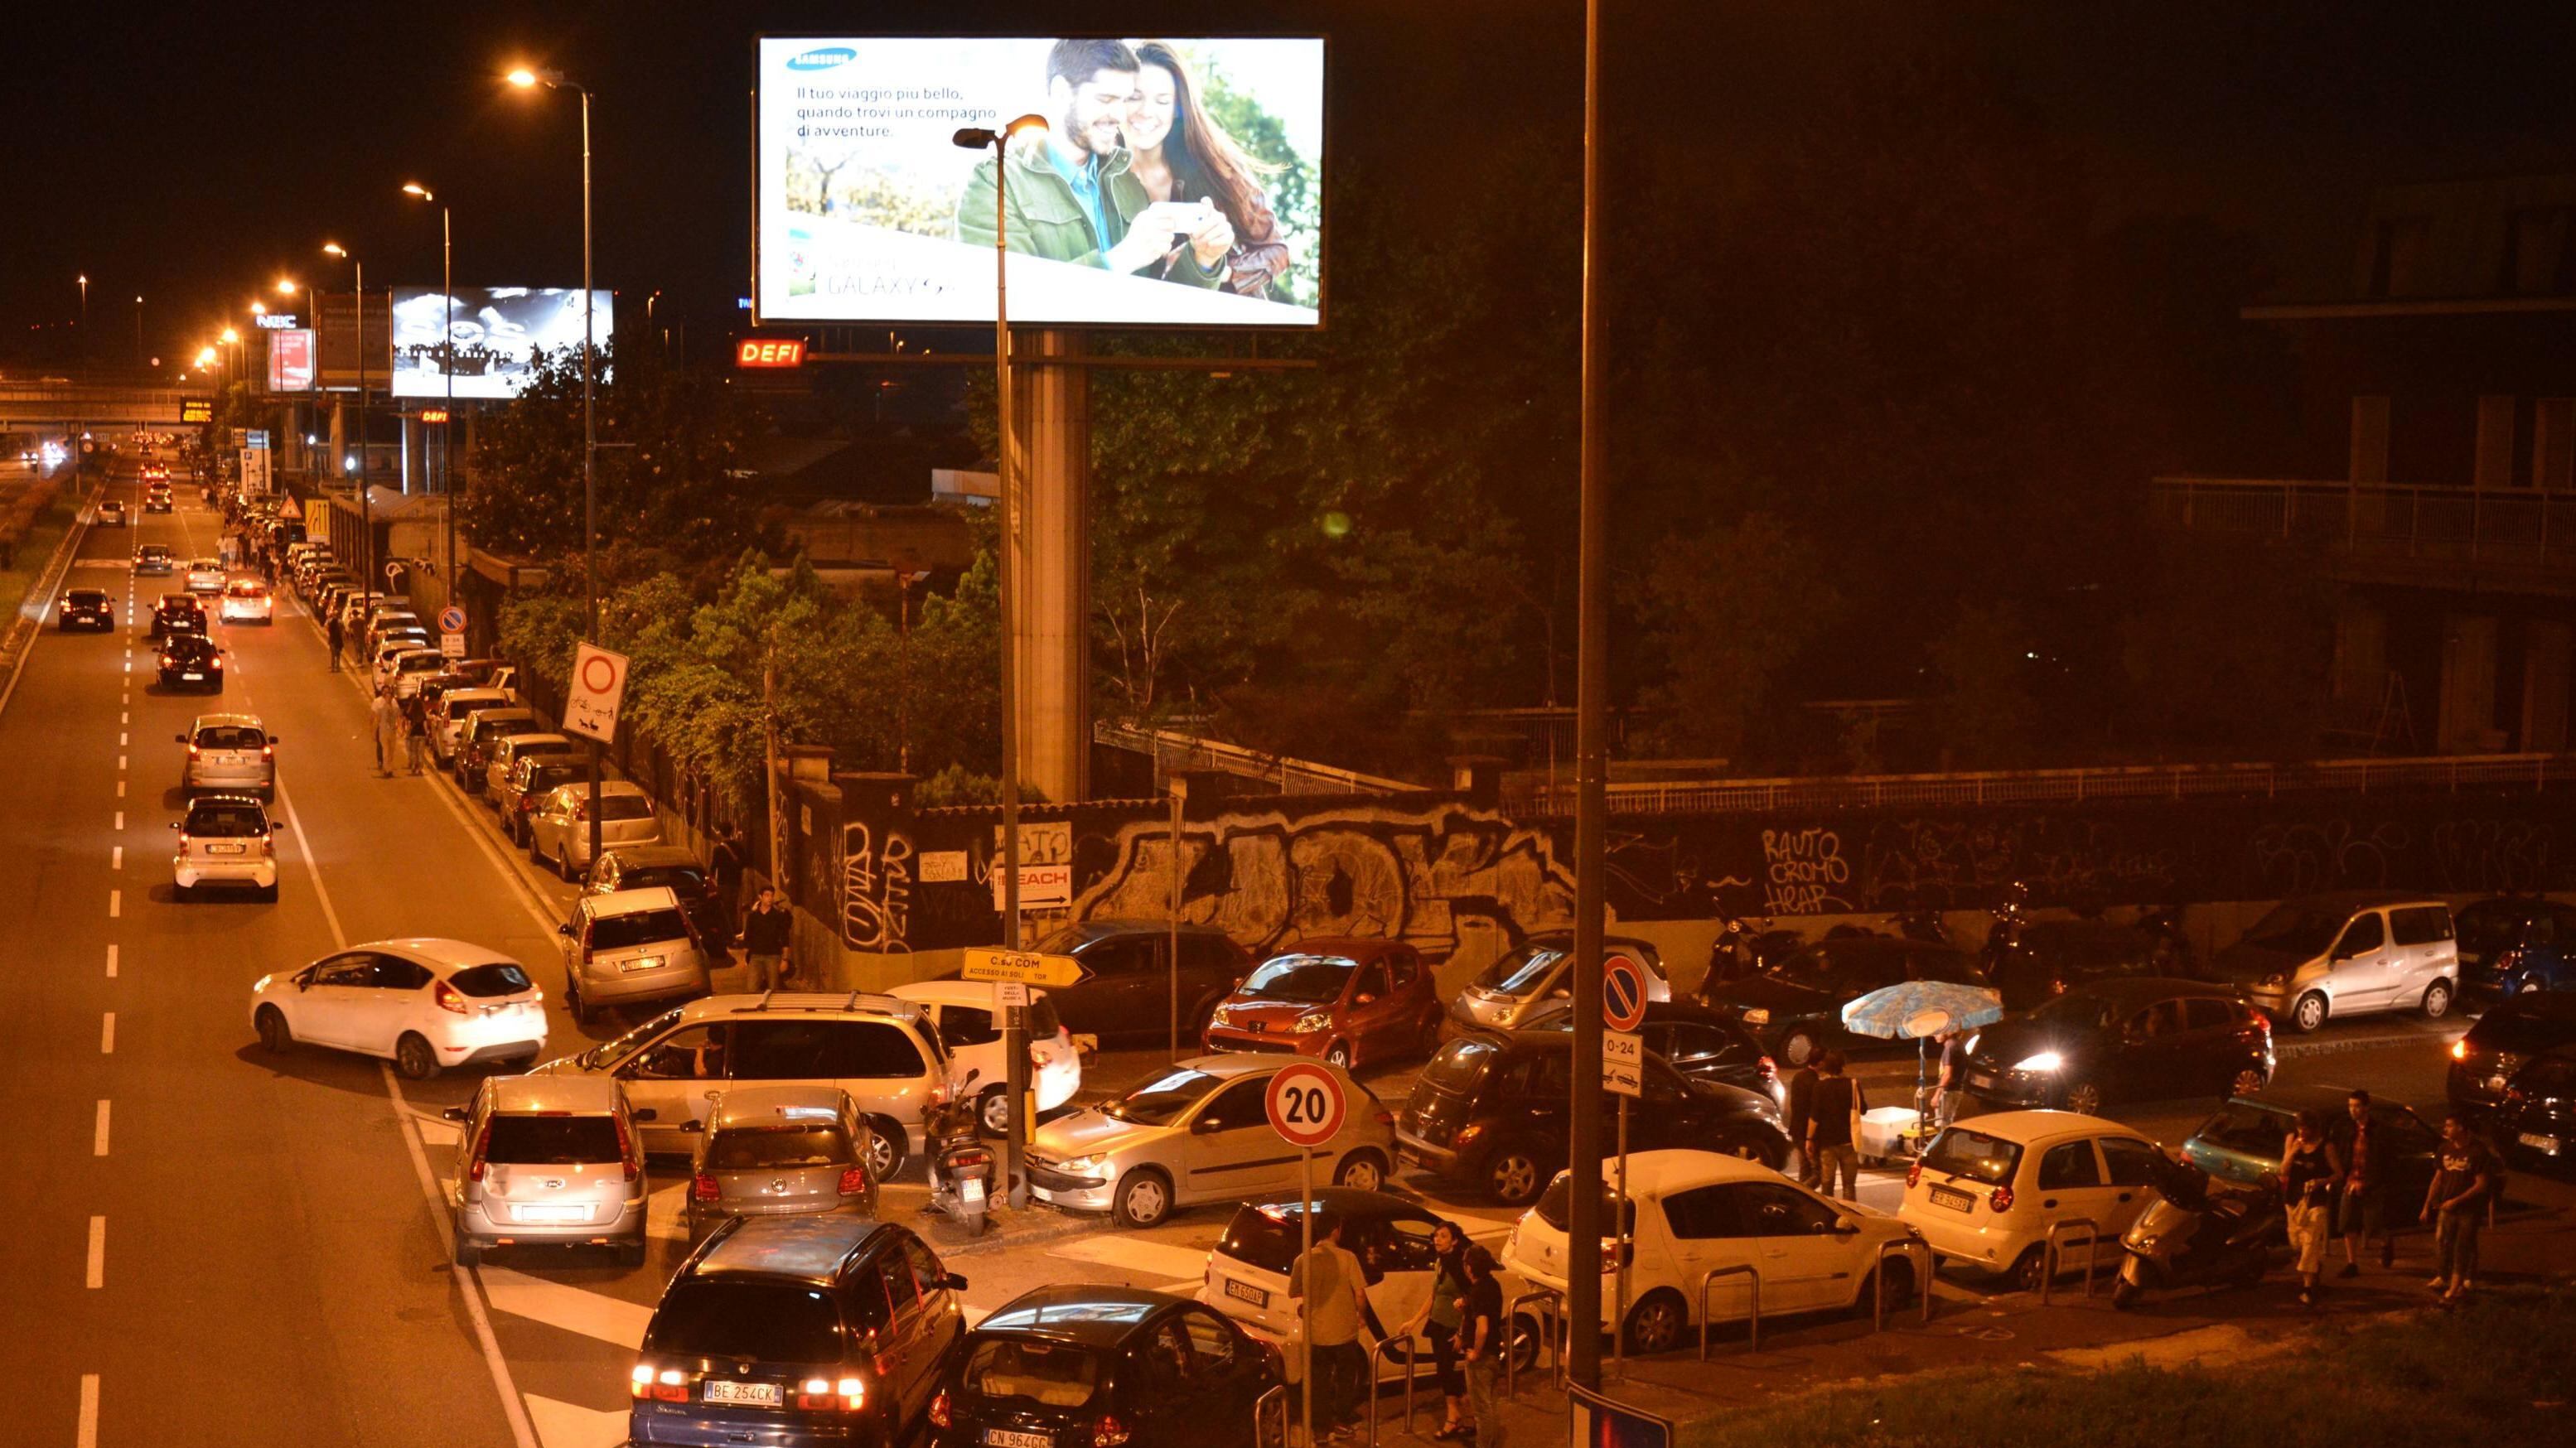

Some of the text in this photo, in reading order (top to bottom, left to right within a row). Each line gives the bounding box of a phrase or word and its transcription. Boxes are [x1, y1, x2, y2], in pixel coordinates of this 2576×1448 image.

[810, 88, 834, 99] tuo
[839, 87, 892, 102] viaggio
[924, 87, 964, 100] bello,
[797, 106, 997, 122] quando trovi un compagno
[797, 124, 810, 137] di
[829, 275, 917, 295] GALAXY
[742, 344, 799, 363] DEFI
[423, 411, 447, 422] DEFI
[969, 967, 999, 976] ACCESSO
[1285, 1087, 1326, 1124] 20
[714, 1384, 772, 1401] BE 254CK
[990, 1431, 1004, 1444] CN
